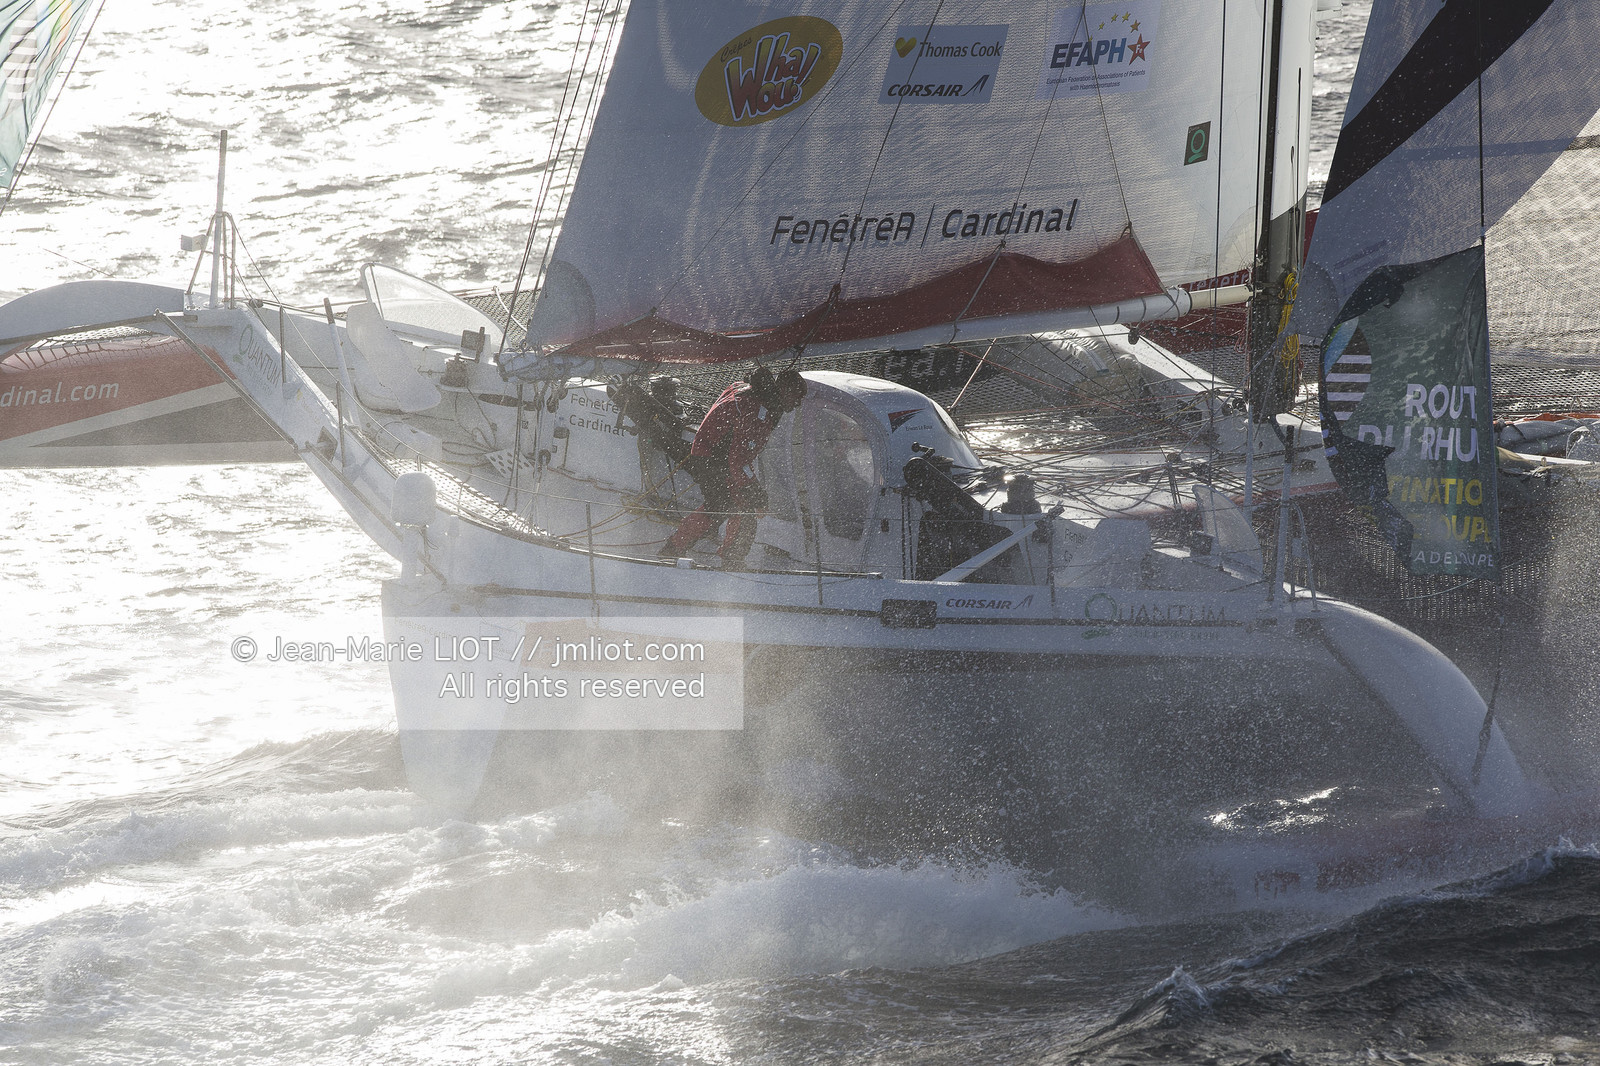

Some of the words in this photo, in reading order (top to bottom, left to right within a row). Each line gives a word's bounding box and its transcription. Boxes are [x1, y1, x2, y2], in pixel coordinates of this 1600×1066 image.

[919, 41, 968, 58] Thomas
[970, 41, 1003, 58] Cook
[1050, 37, 1127, 69] EFAPH
[887, 84, 964, 97] CORSAIR
[941, 198, 1079, 238] Cardinal
[0, 381, 120, 408] dinal.com
[945, 598, 1012, 610] CORSAIR
